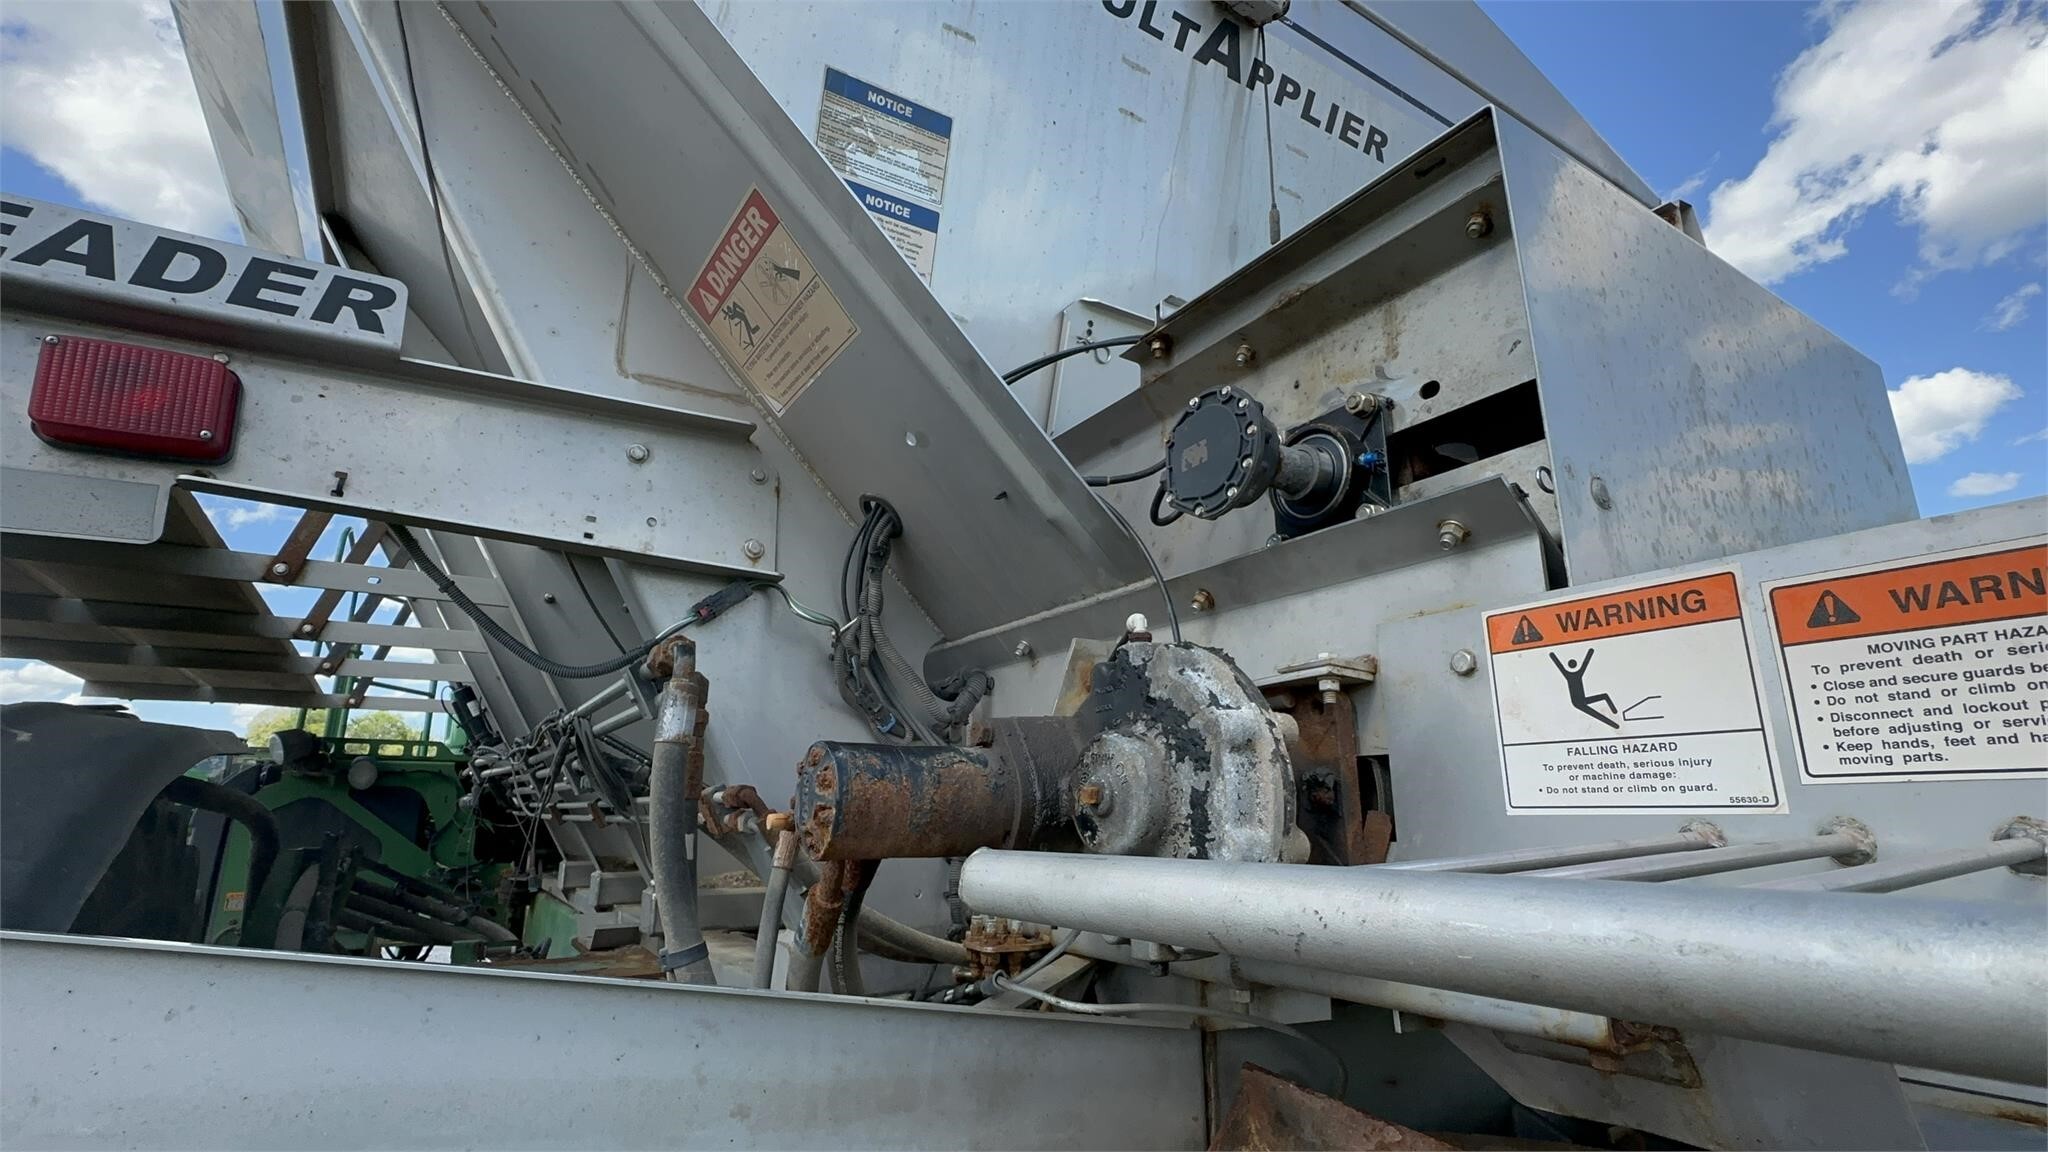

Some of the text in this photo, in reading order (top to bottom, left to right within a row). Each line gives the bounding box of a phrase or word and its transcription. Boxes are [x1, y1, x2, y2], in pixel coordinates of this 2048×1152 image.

[867, 91, 913, 118] NOTICE
[865, 193, 911, 218] NOTICE
[706, 206, 769, 297] DANGER
[1555, 589, 1707, 633] WARNING
[1867, 625, 2048, 655] MOVING PART HAZA
[1811, 664, 1830, 676] To
[1840, 657, 1902, 675] prevent
[1912, 650, 1962, 665] death
[1975, 648, 1994, 659] or
[1823, 680, 1865, 691] Close
[1869, 675, 1898, 688] and
[1902, 671, 1958, 685] secure
[1963, 664, 2025, 682] guards
[1826, 695, 1846, 706] Do
[1855, 693, 1879, 704] not
[1888, 688, 1931, 701] stand
[1941, 688, 1957, 697] or
[1968, 681, 2016, 695] climb
[1830, 707, 1914, 722] Disconnect
[1923, 704, 1953, 716] and
[1963, 699, 2029, 714] lockout
[1833, 714, 2048, 737] before adjusting or servi
[1567, 742, 1678, 756] FALLING HAZARD
[1836, 741, 1873, 753] Keep
[1882, 737, 1935, 750] hands,
[1944, 736, 1976, 747] feet
[1986, 733, 2019, 745] and
[1542, 758, 1712, 772] To prevent death, serious injury
[1840, 751, 1949, 766] moving parts.
[1582, 772, 1625, 780] machine
[1629, 771, 1676, 780] damage:
[1546, 786, 1559, 794] Do
[1582, 785, 1609, 793] stand
[1627, 784, 1657, 793] climb
[1679, 783, 1718, 793] guard.
